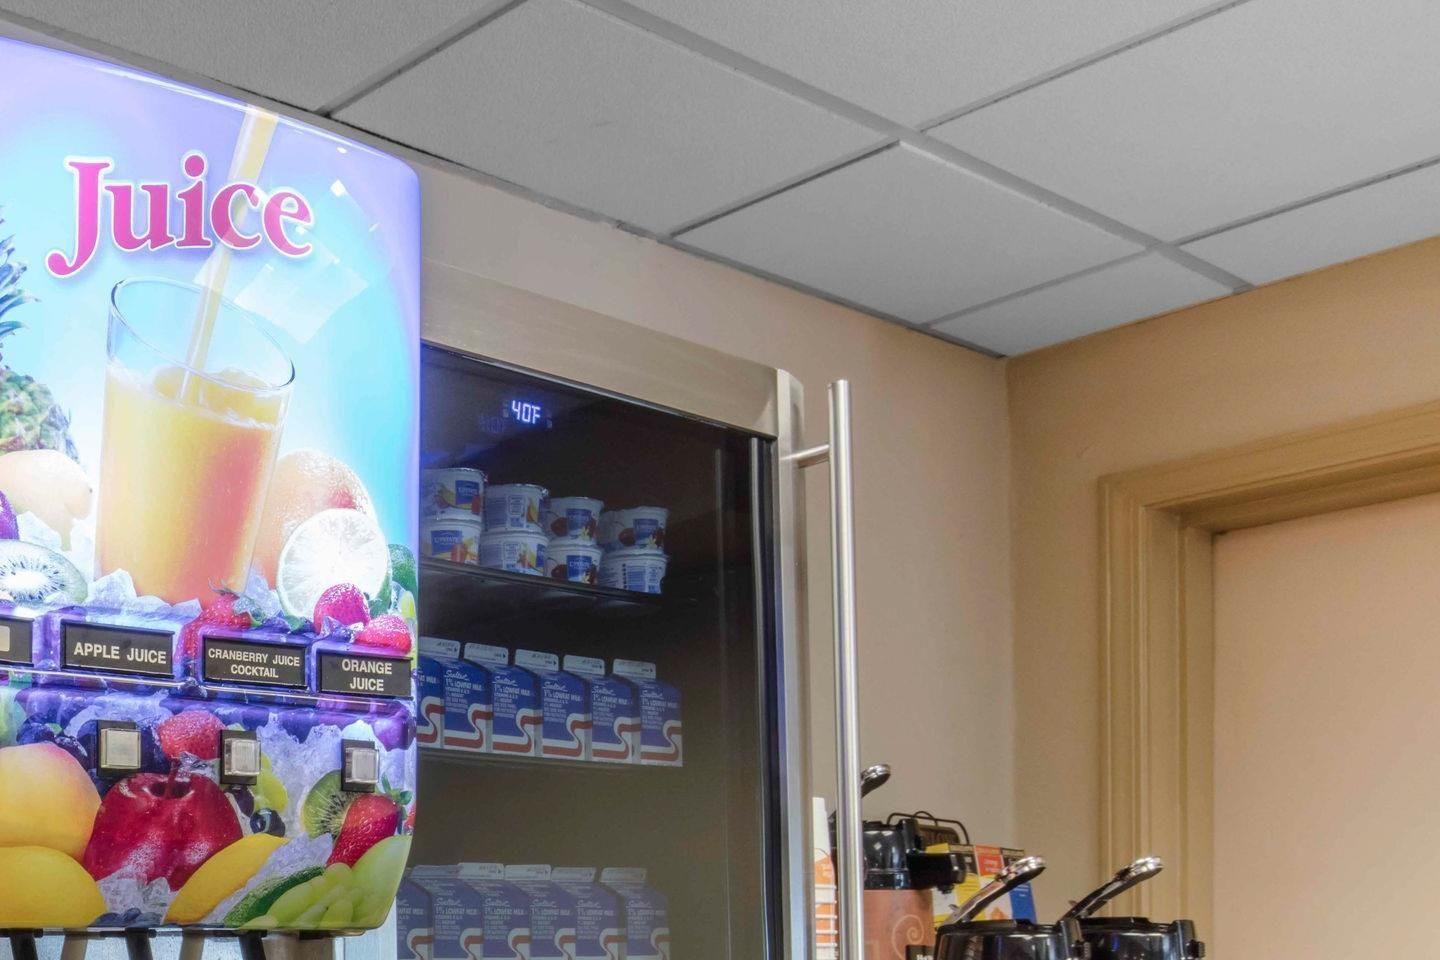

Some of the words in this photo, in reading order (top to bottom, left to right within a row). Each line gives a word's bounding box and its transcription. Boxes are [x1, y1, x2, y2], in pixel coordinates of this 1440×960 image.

[46, 151, 313, 276] Juice
[512, 400, 541, 424] 40F
[73, 642, 120, 661] APPLE
[127, 648, 167, 665] JUICE
[208, 648, 269, 664] CRANBERRY
[272, 654, 300, 667] JUICE
[230, 665, 279, 679] COCKTAIL
[341, 659, 393, 676] ORANGE
[349, 678, 384, 692] JUICE
